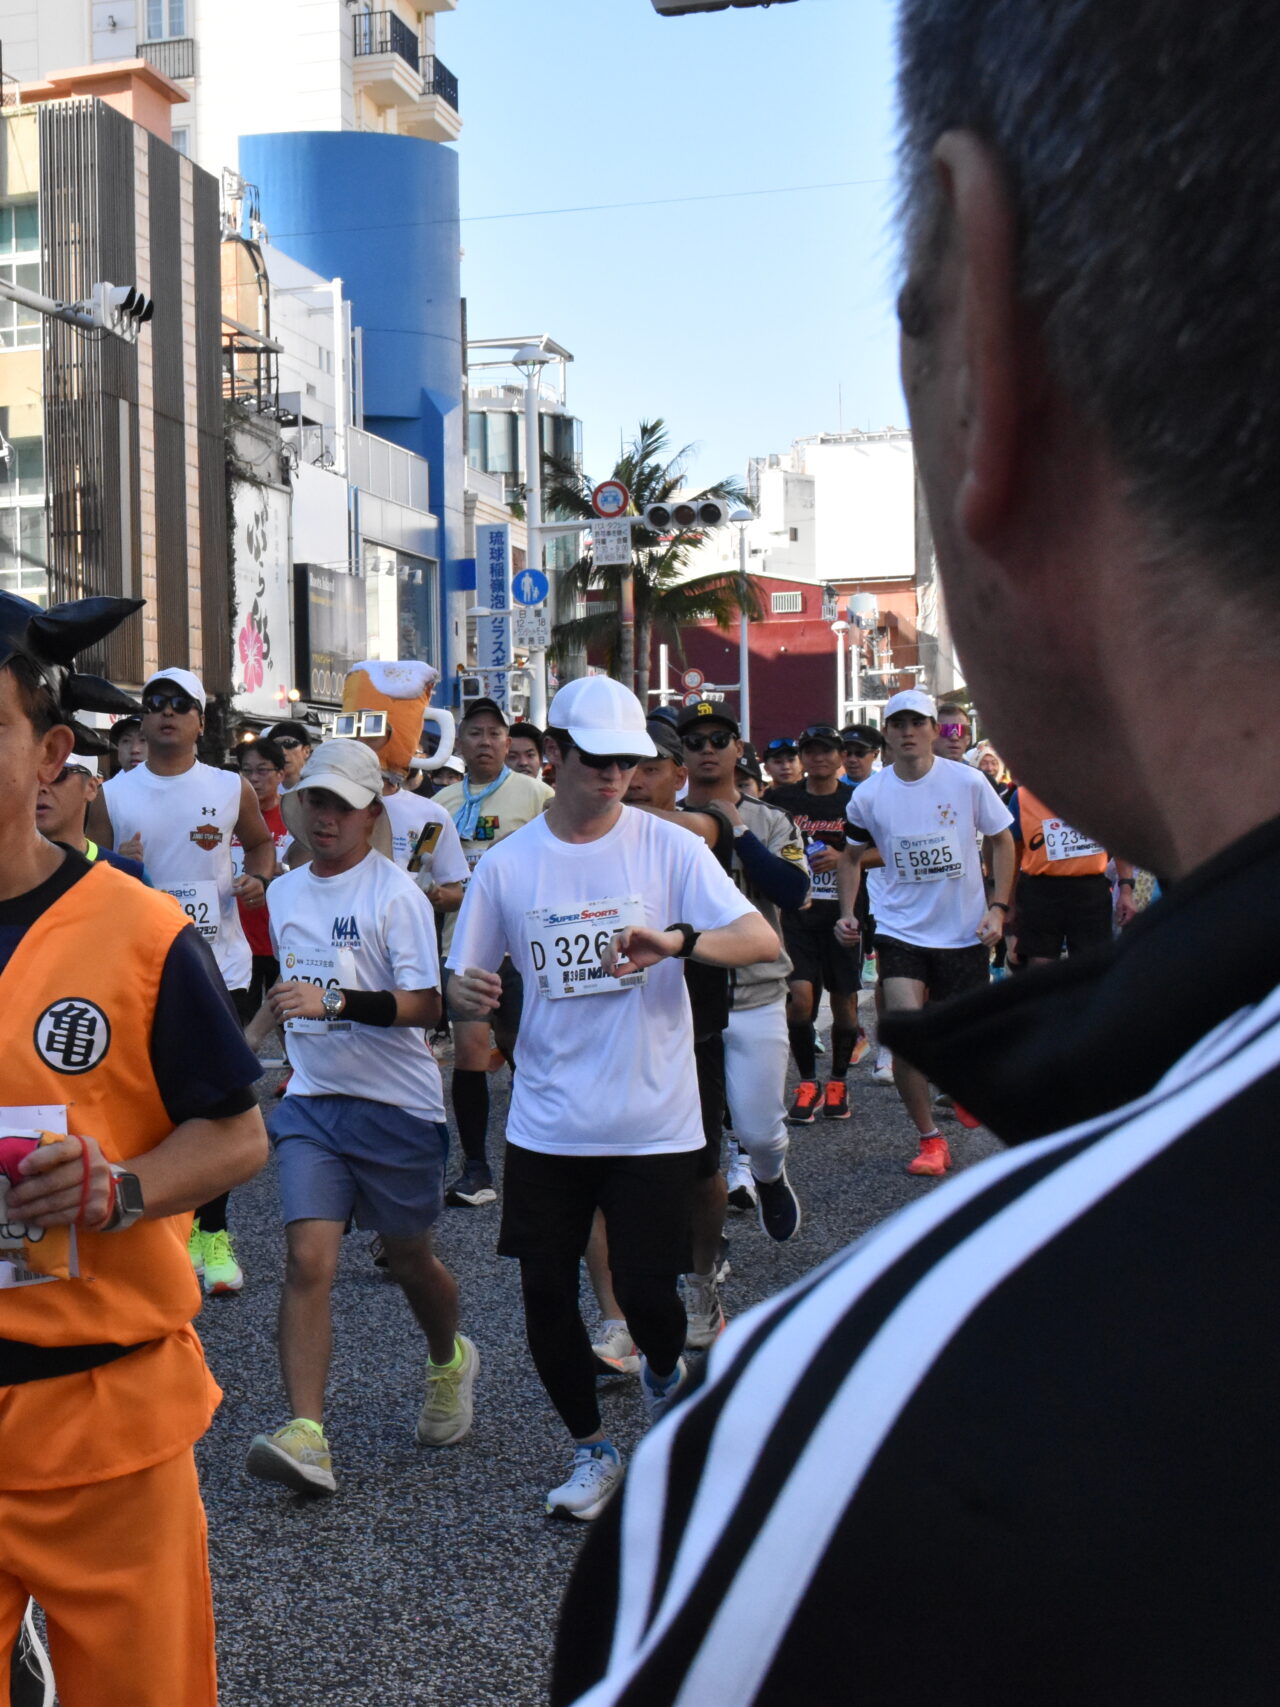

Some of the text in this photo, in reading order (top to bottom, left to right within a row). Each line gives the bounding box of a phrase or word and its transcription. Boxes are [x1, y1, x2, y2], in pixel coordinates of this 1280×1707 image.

[1047, 833, 1056, 848] C
[895, 846, 952, 868] E 5825
[530, 941, 546, 971] D
[46, 1002, 98, 1067] 亀
